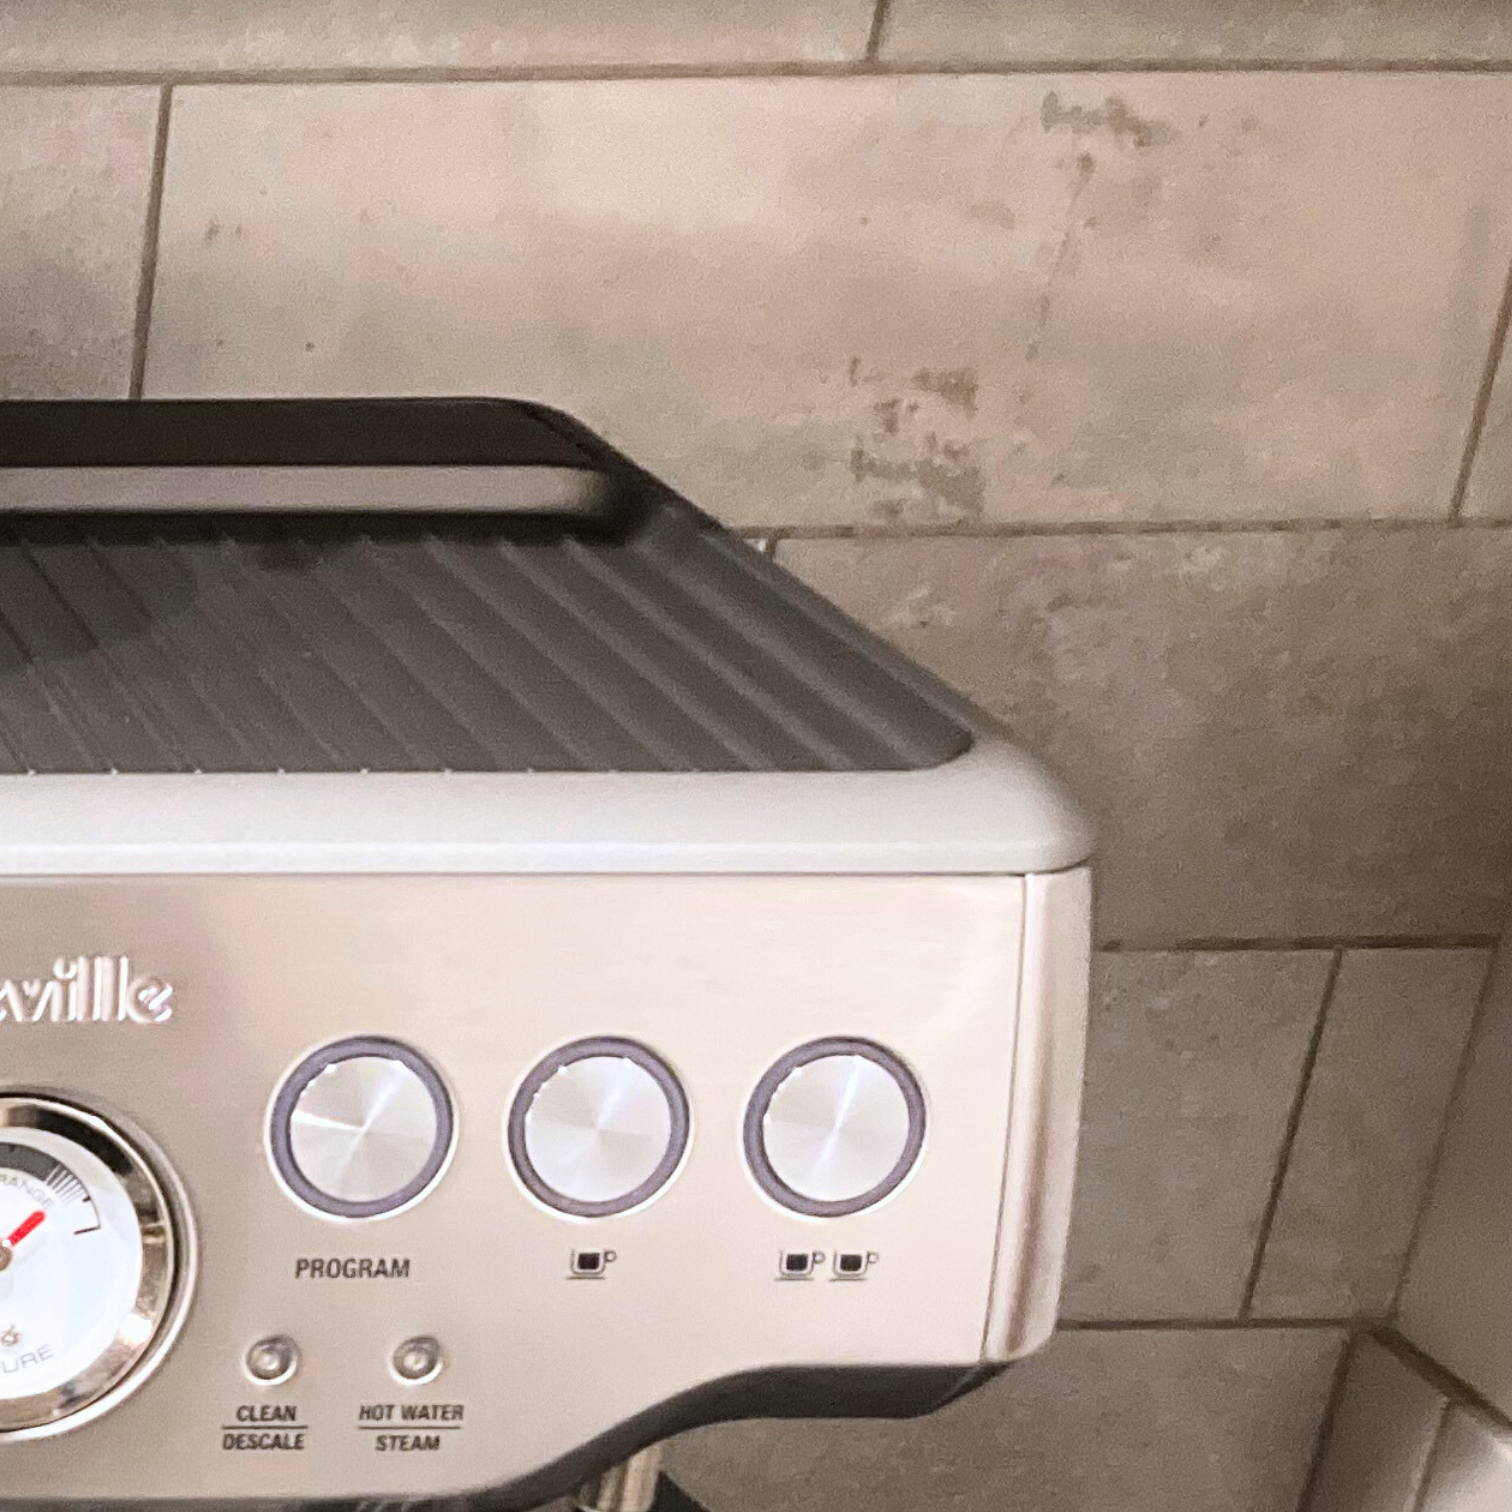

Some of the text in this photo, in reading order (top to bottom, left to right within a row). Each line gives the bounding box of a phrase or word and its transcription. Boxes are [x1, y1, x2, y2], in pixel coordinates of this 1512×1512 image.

[294, 1257, 411, 1280] PROGRAM
[235, 1404, 298, 1422] CLEAN
[358, 1403, 465, 1422] HOT WATER
[221, 1432, 306, 1451] DESCALE
[374, 1434, 441, 1452] STEAM
